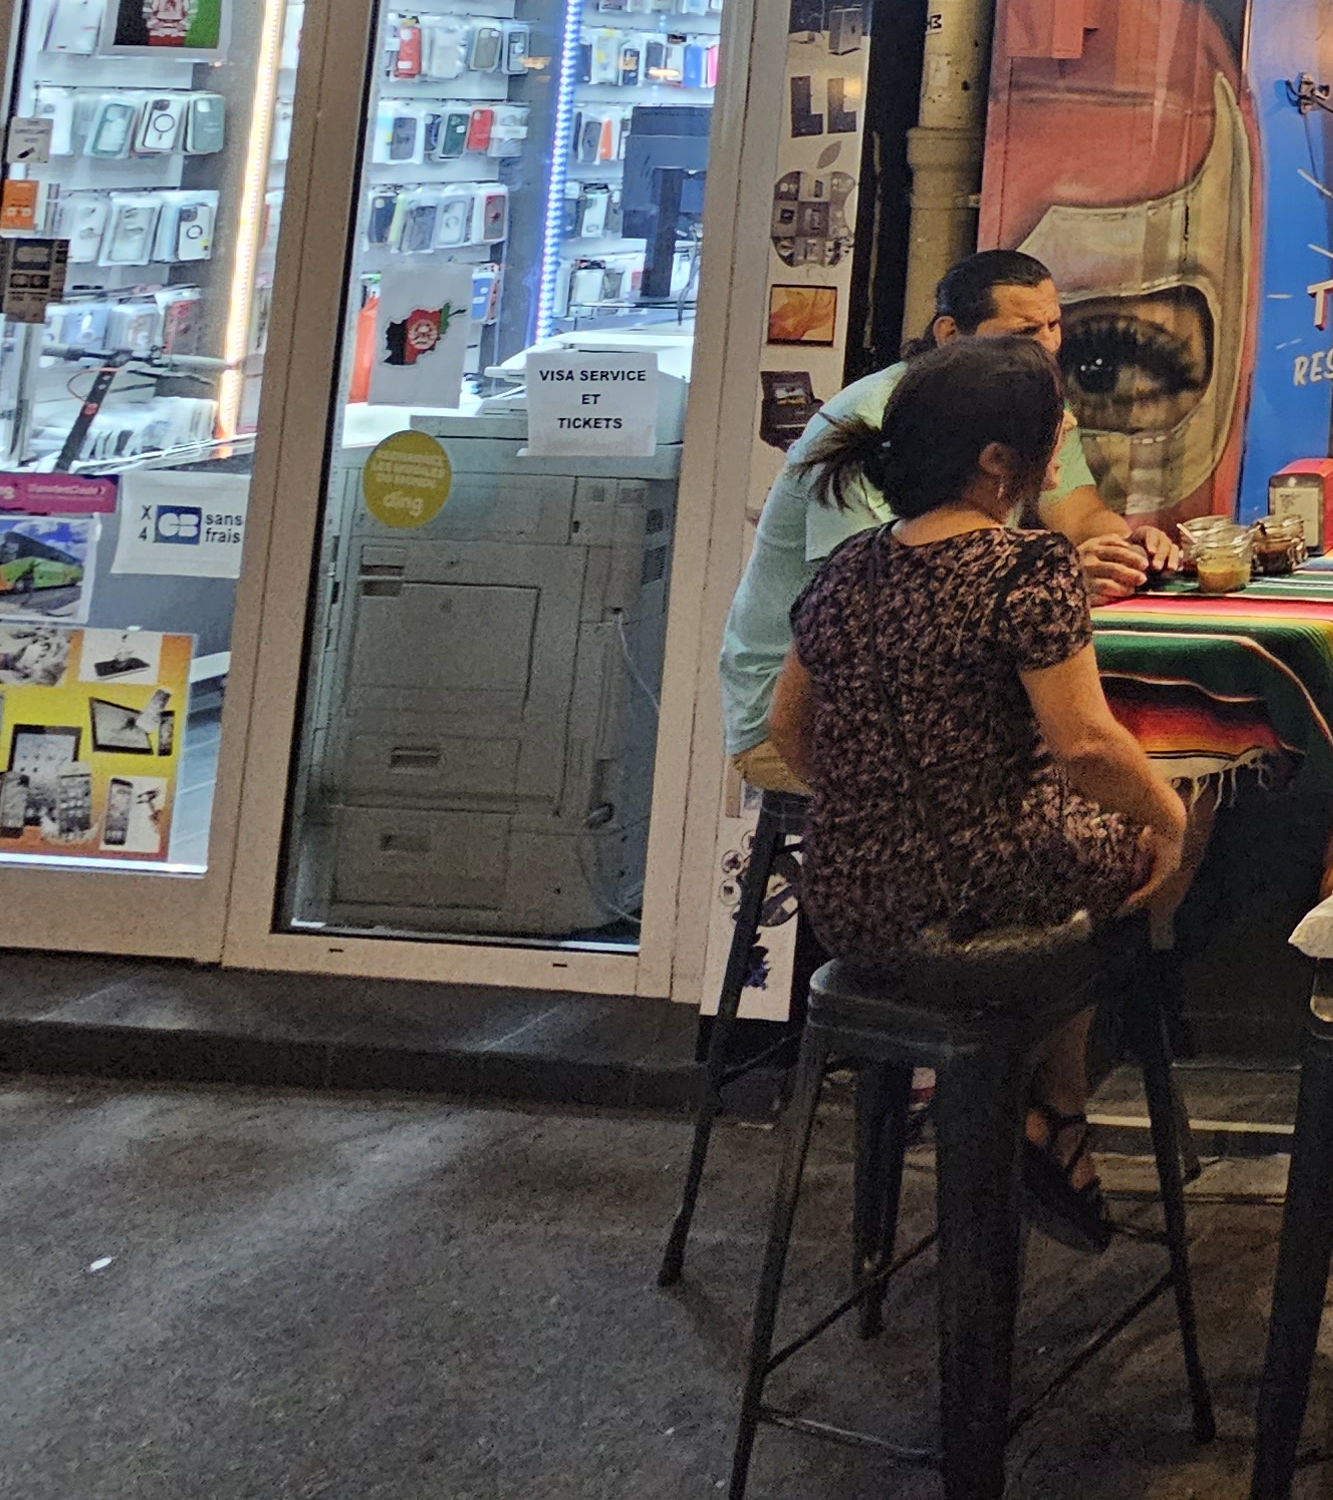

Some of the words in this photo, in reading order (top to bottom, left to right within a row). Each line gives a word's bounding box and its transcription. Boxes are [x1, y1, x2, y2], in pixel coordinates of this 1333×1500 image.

[539, 369, 575, 382] VISA
[579, 369, 647, 382] SERVICE
[581, 393, 601, 405] ET
[557, 417, 623, 429] TICKETS
[205, 512, 244, 527] sans
[138, 527, 148, 541] 4
[205, 528, 241, 544] frais
